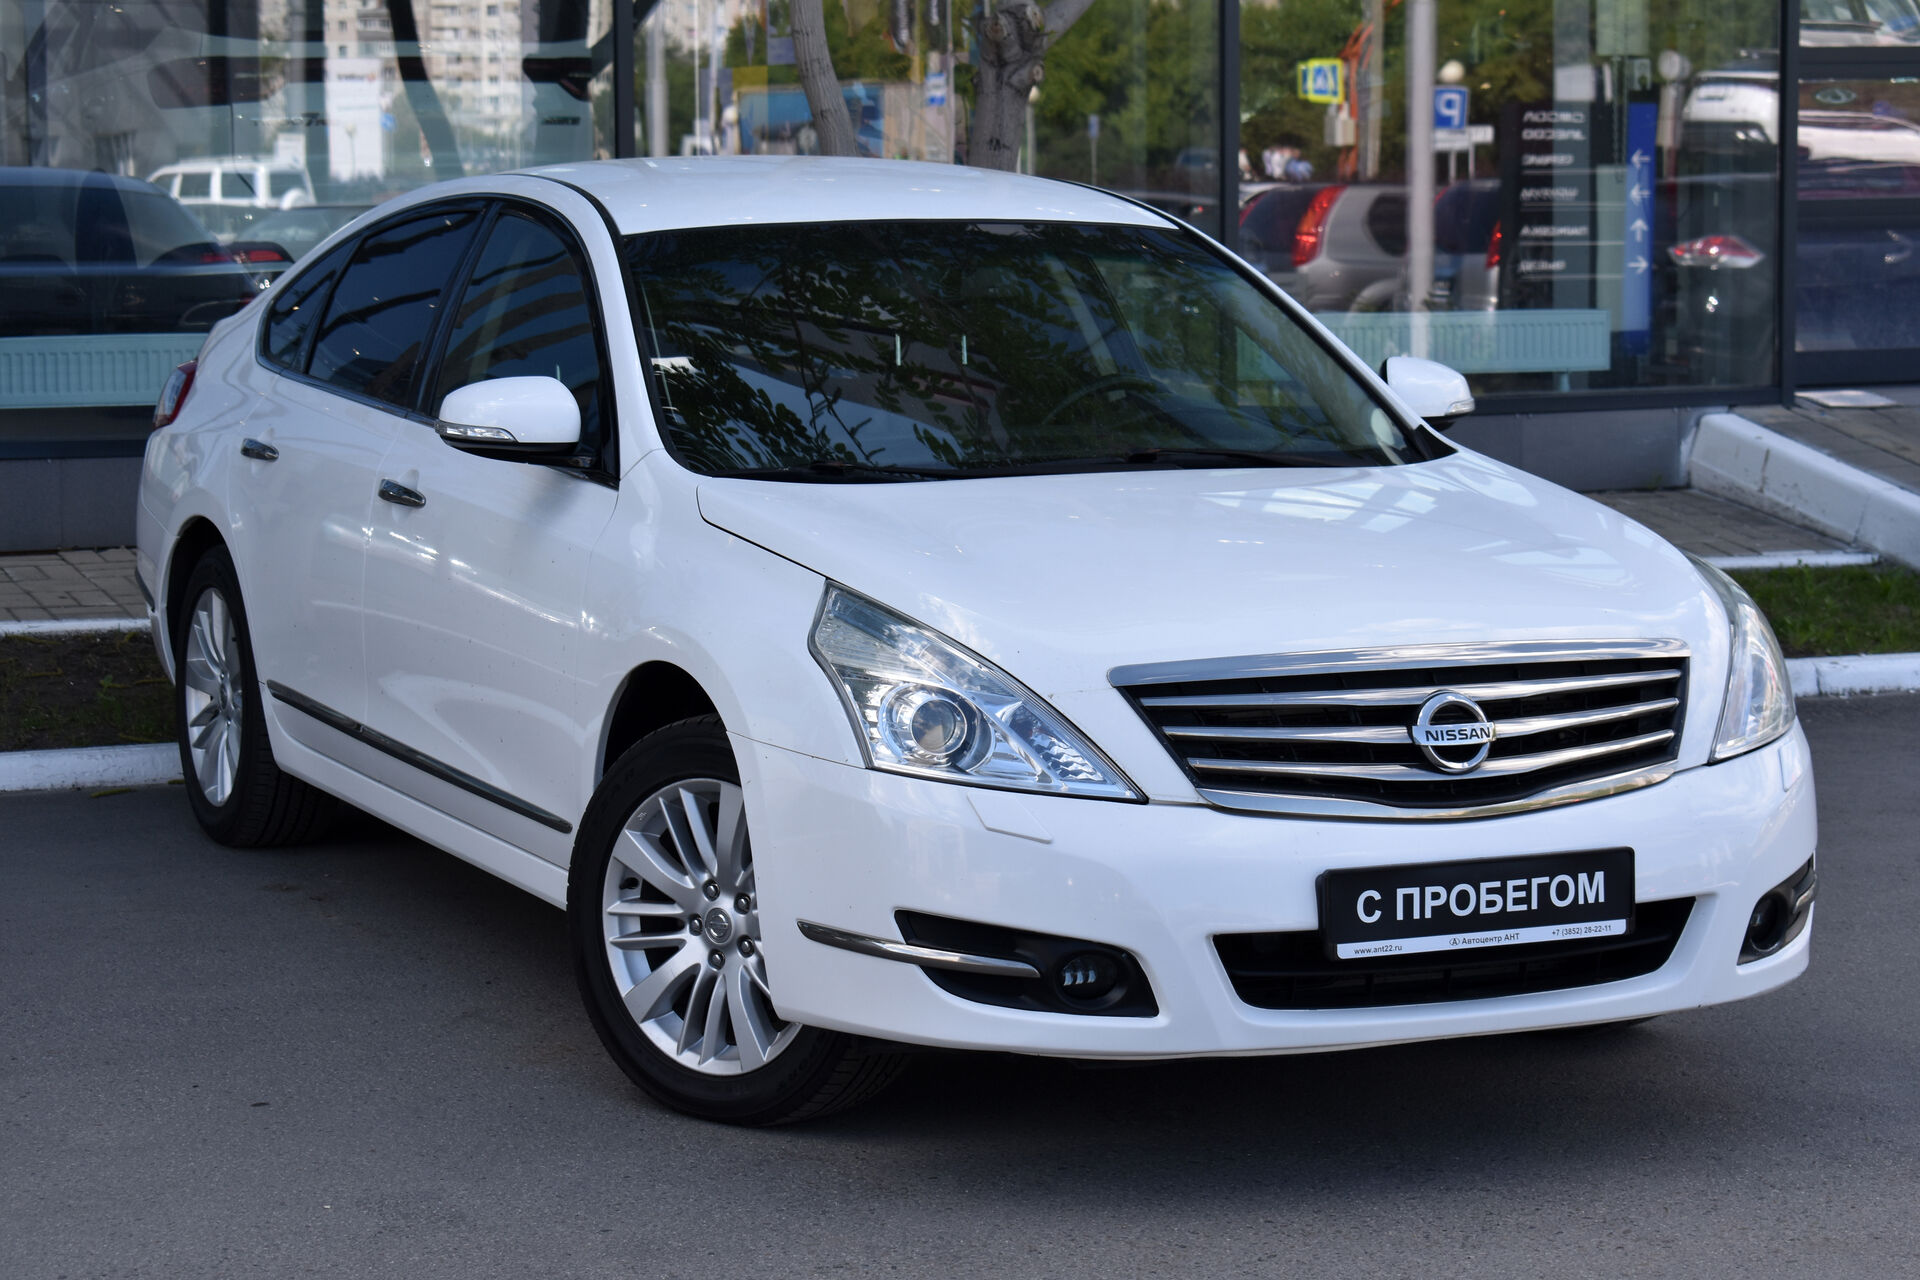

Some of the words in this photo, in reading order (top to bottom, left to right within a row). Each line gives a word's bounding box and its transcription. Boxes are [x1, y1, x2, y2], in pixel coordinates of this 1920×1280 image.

[1425, 727, 1491, 742] NISSAN
[1356, 889, 1383, 924] С
[1395, 870, 1606, 921] ПРОБЕГОМ
[1552, 928, 1560, 936] +7
[1561, 926, 1583, 937] (3852)
[1583, 924, 1612, 935] 28-22-11
[1461, 936, 1503, 945] Автоцентр
[1504, 932, 1520, 941] АНТ
[1353, 944, 1403, 955] www.ant22.ru
